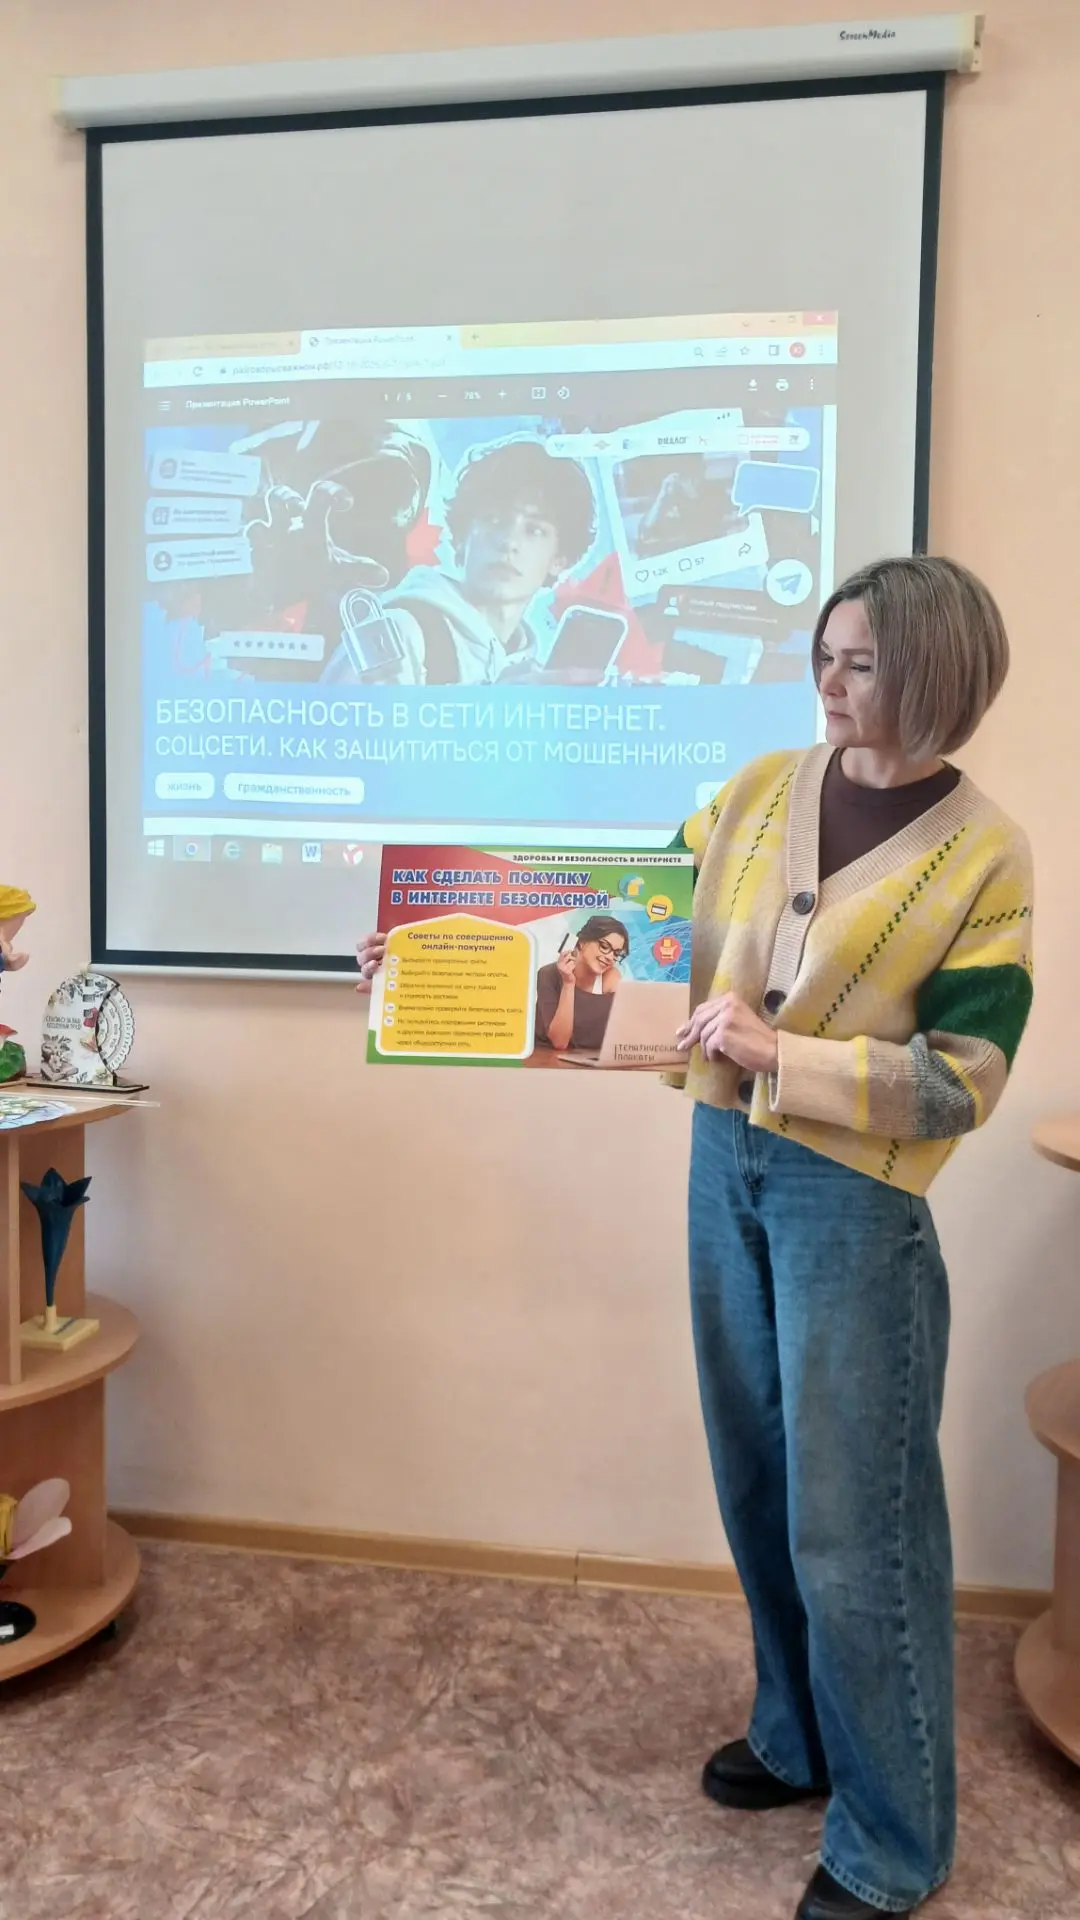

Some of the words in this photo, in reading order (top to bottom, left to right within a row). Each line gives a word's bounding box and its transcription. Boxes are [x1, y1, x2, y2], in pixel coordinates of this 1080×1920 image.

[839, 30, 896, 40] ScreenMedia
[186, 400, 241, 409] Презентация
[243, 397, 290, 406] PowerPoint
[156, 698, 384, 728] БЕЗОПАСНОСТЬ
[393, 702, 408, 728] В
[419, 702, 495, 728] СЕТИ
[504, 704, 666, 731] ИНТЕРНЕТ.
[155, 736, 272, 760] СОЦСЕТИ.
[280, 737, 328, 759] КАК
[334, 738, 498, 764] ЗАЩИТИТЬСЯ
[506, 740, 538, 762] ОТ
[544, 740, 727, 765] МОШЕННИКОВ
[168, 782, 202, 792] жизнь
[238, 782, 350, 797] гражданственность
[512, 854, 556, 862] ЗДОРОВЬЕ
[565, 855, 628, 863] БЕЗОПАСНОСТЬ
[637, 856, 682, 864] ИНТЕРНЕТЕ
[392, 869, 427, 884] КАК
[432, 870, 501, 886] СДЕЛАТЬ
[508, 870, 592, 886] ПОКУПКУ
[391, 890, 404, 905] В
[408, 891, 494, 906] ИНТЕРНЕТЕ
[501, 890, 610, 908] БЕЗОПАСНОЙ
[408, 932, 440, 940] Советы
[456, 934, 514, 942] совершению
[422, 943, 496, 952] онлайн-покупки
[618, 1044, 678, 1052] ТЕМАТИЧЕСКИ
[618, 1054, 655, 1062] ПЛАКАТЫ
